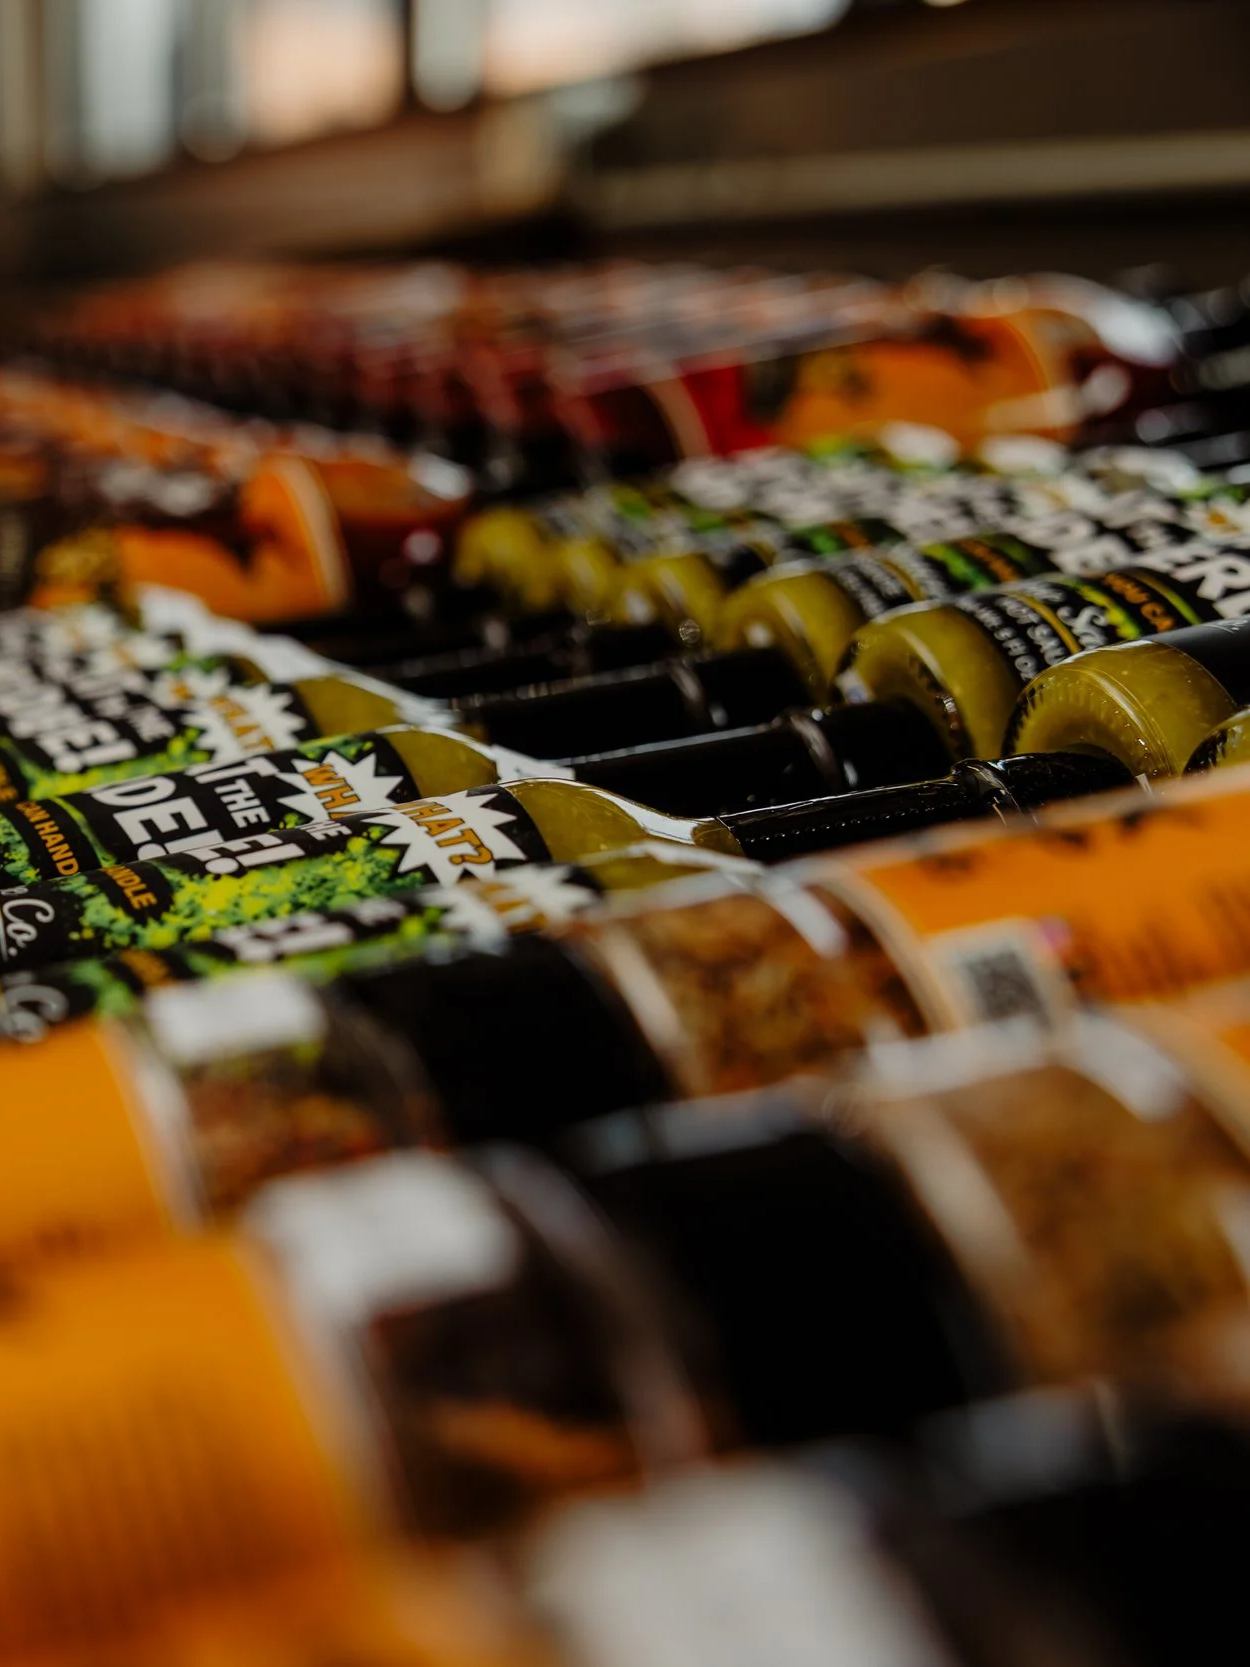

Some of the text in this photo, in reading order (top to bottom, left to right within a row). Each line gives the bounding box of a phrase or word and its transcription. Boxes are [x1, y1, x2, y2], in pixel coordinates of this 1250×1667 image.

[214, 778, 271, 829] THE
[33, 819, 80, 876] HAND
[1, 897, 56, 958] Co.
